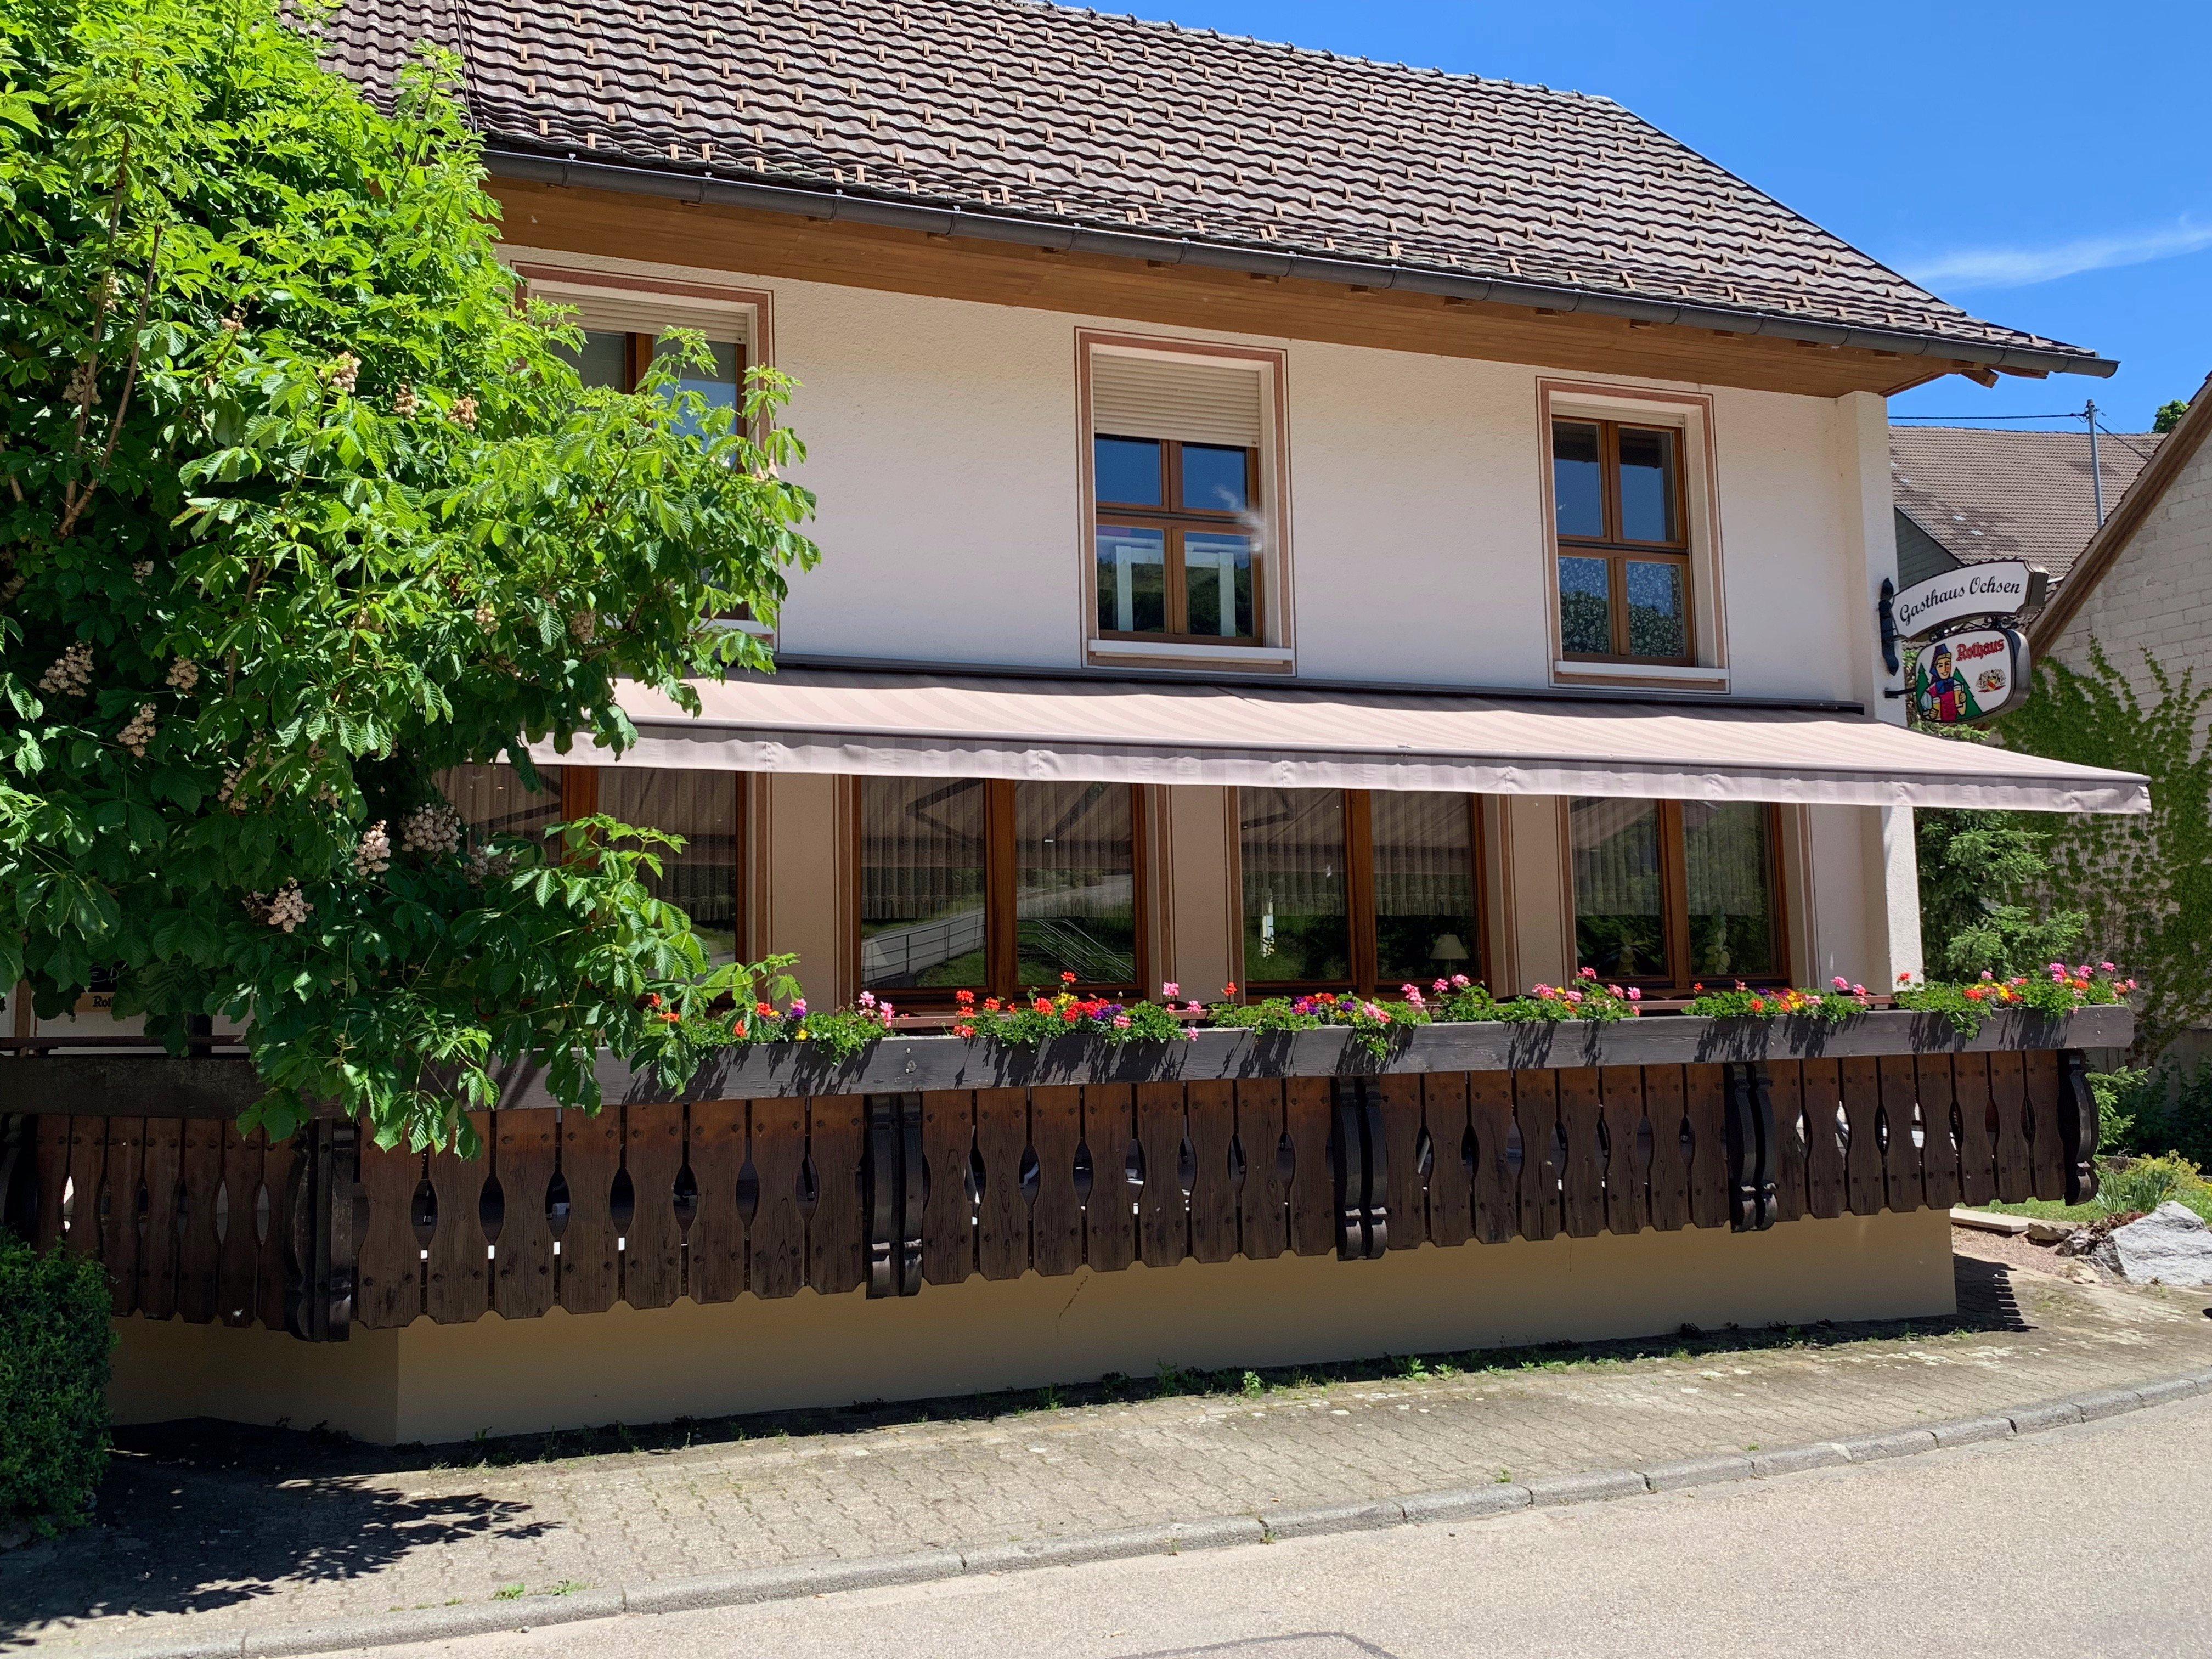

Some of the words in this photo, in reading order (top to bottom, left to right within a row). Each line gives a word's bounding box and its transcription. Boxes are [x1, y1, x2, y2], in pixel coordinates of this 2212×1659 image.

[1900, 586, 1965, 626] Gasthaus
[1969, 576, 2021, 594] Ochsen
[1956, 639, 2004, 661] Rothaus
